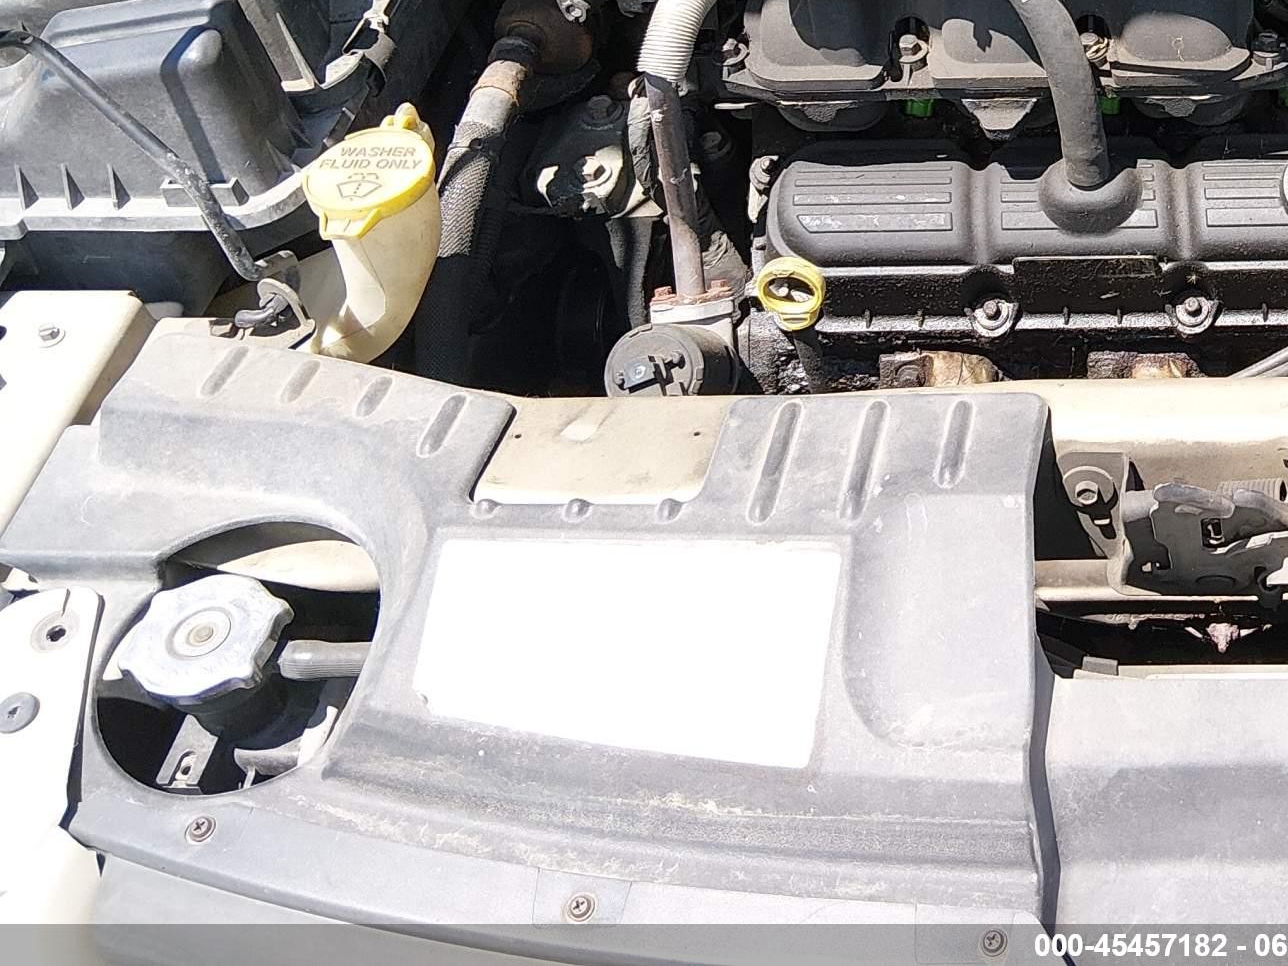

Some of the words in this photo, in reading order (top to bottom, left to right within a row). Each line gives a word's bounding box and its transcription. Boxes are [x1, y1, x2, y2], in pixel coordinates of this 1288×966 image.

[341, 146, 416, 157] WASHER
[319, 159, 371, 170] FLUID
[375, 159, 422, 170] ONLY
